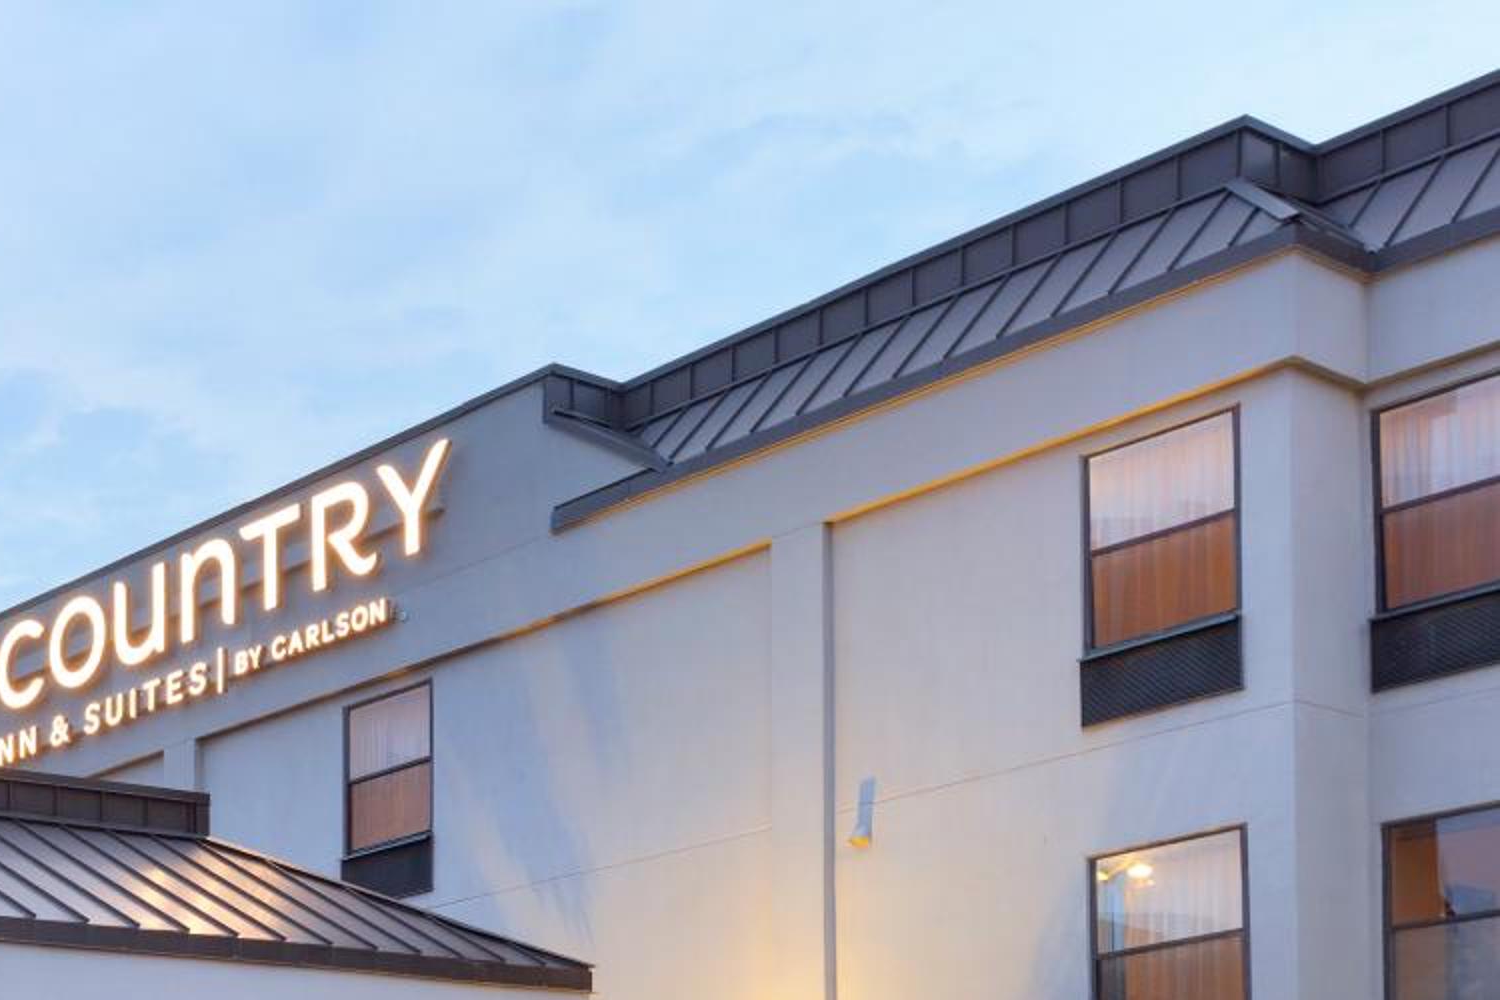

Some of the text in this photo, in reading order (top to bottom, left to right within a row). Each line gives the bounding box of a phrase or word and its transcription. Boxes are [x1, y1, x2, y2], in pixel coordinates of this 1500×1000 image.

[49, 714, 72, 748] &
[83, 661, 208, 735] SUITES
[234, 644, 262, 676] BY
[270, 597, 388, 661] CARLSON
